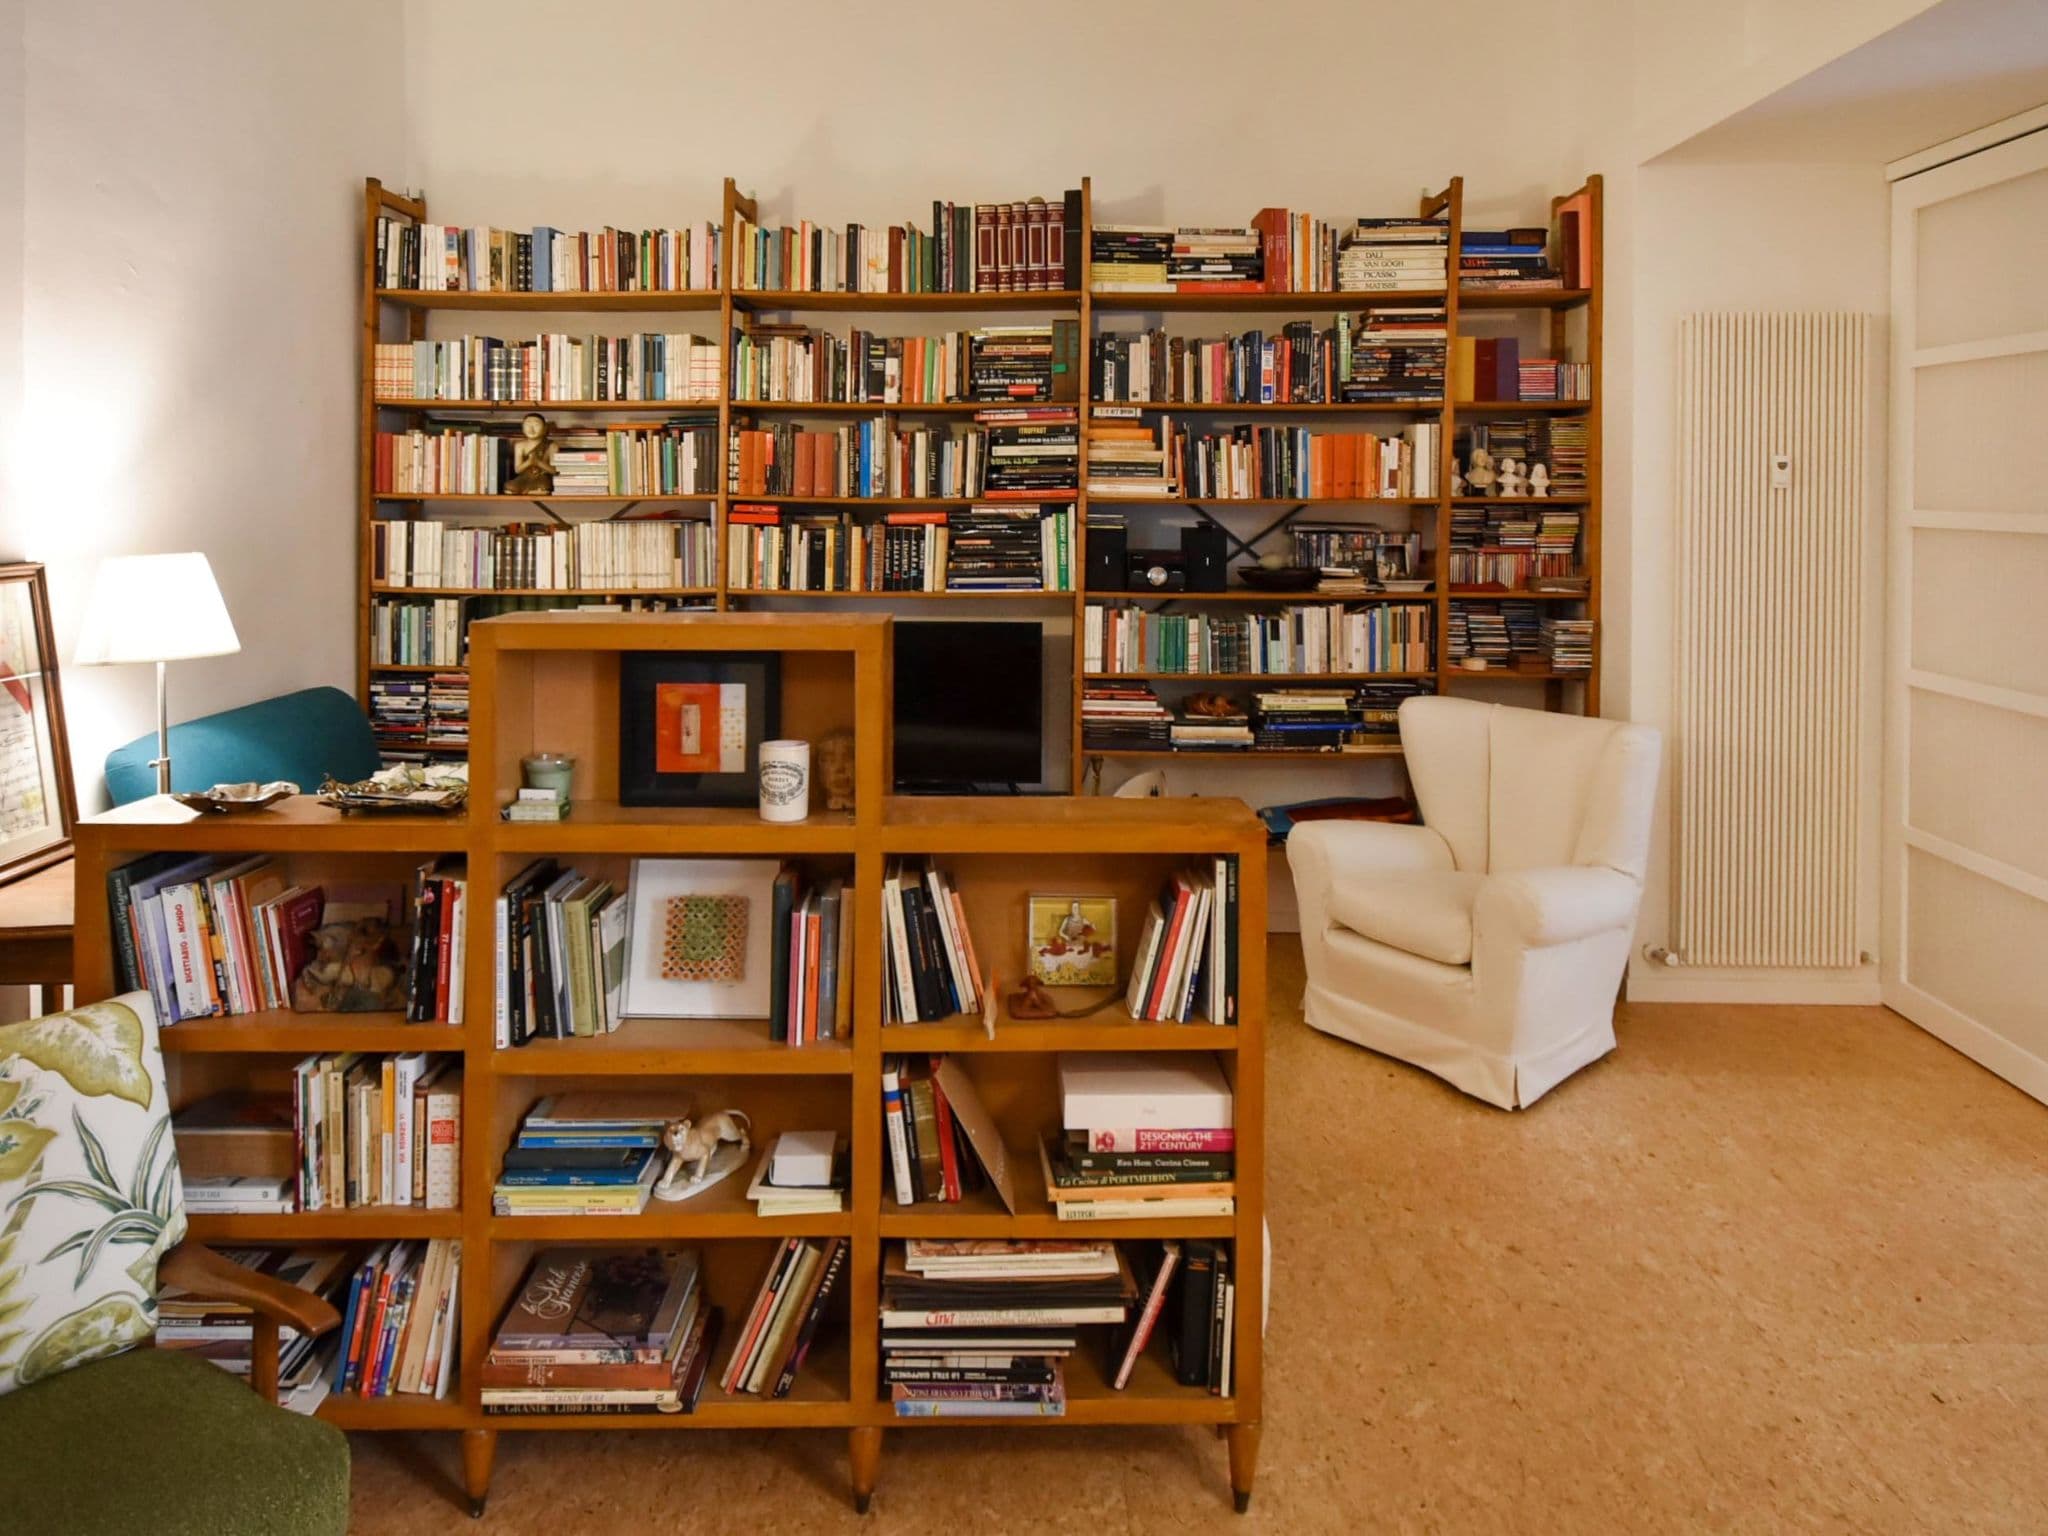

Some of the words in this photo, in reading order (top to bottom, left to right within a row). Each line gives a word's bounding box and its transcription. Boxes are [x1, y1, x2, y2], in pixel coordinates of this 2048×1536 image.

[175, 903, 185, 932] MONDO
[180, 940, 192, 983] RICETTARIO
[1140, 1131, 1193, 1141] DESIGNING
[1194, 1132, 1213, 1141] THE
[1159, 1142, 1203, 1150] CENTURY
